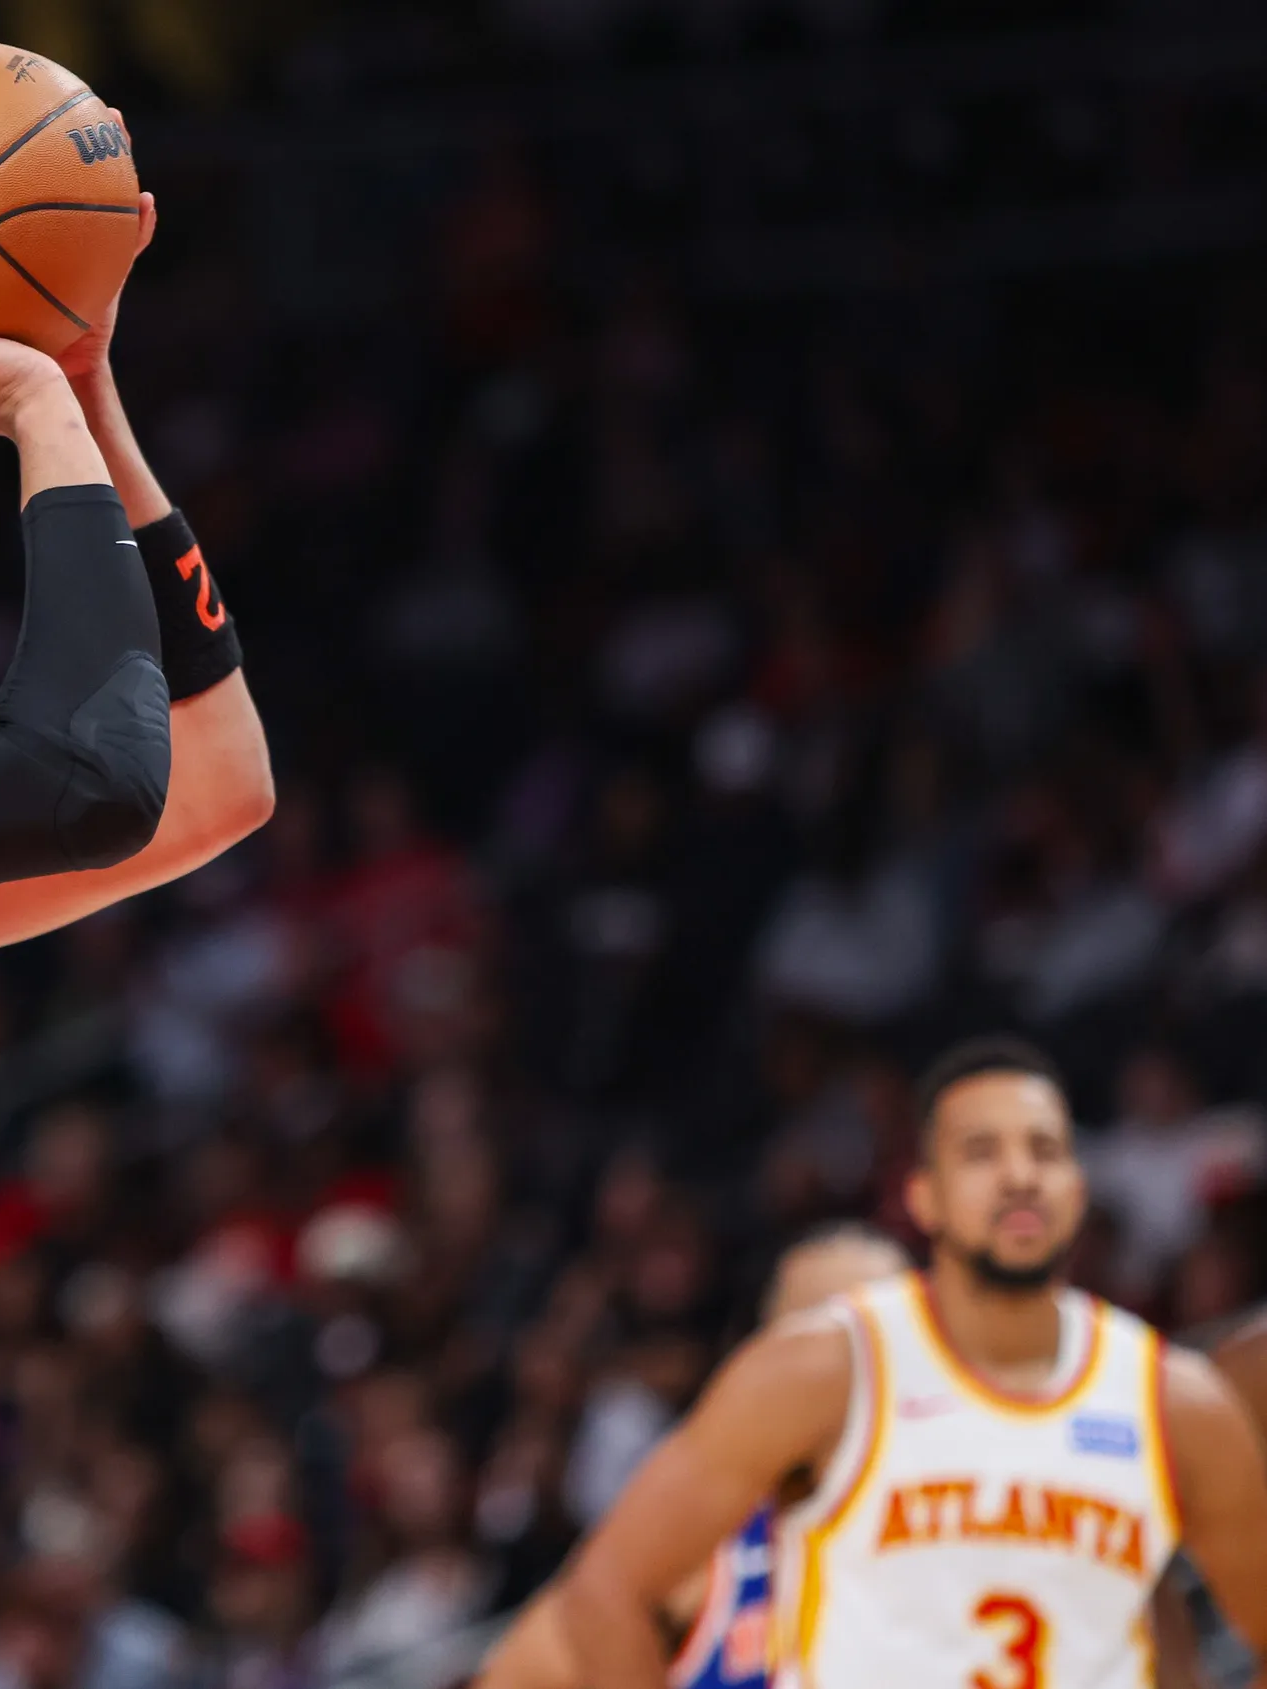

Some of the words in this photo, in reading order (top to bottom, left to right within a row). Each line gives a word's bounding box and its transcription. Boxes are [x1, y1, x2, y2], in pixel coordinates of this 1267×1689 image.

[175, 543, 227, 632] 2
[873, 1475, 1150, 1580] ATLANTA
[970, 1588, 1053, 1689] 3
